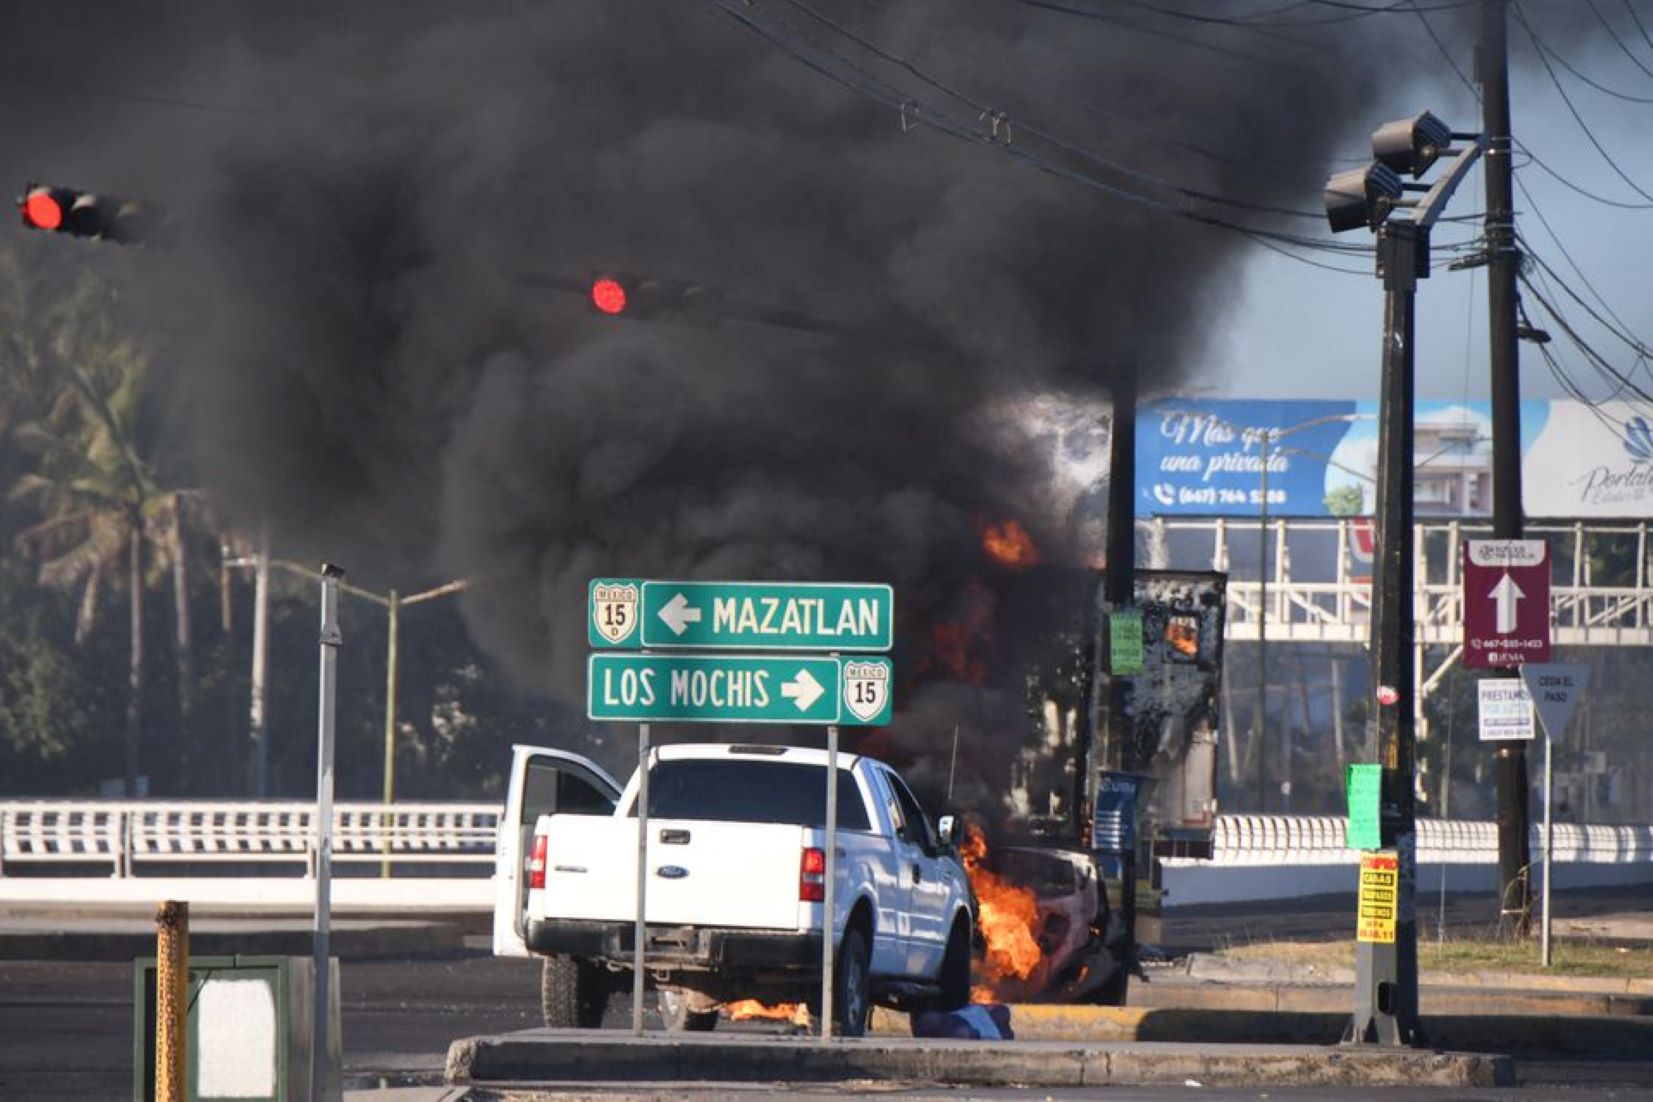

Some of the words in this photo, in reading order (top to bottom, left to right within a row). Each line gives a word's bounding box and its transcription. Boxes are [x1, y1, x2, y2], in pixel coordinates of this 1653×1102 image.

[1160, 454, 1201, 472] una
[605, 603, 626, 626] 15
[712, 597, 879, 635] MAZATLAN
[611, 628, 618, 636] D
[603, 668, 656, 706] LOS
[671, 669, 769, 708] MOCHIS
[1539, 676, 1561, 687] CEDA
[1562, 676, 1574, 688] EL
[855, 681, 876, 704] 15
[1544, 691, 1568, 703] PASO
